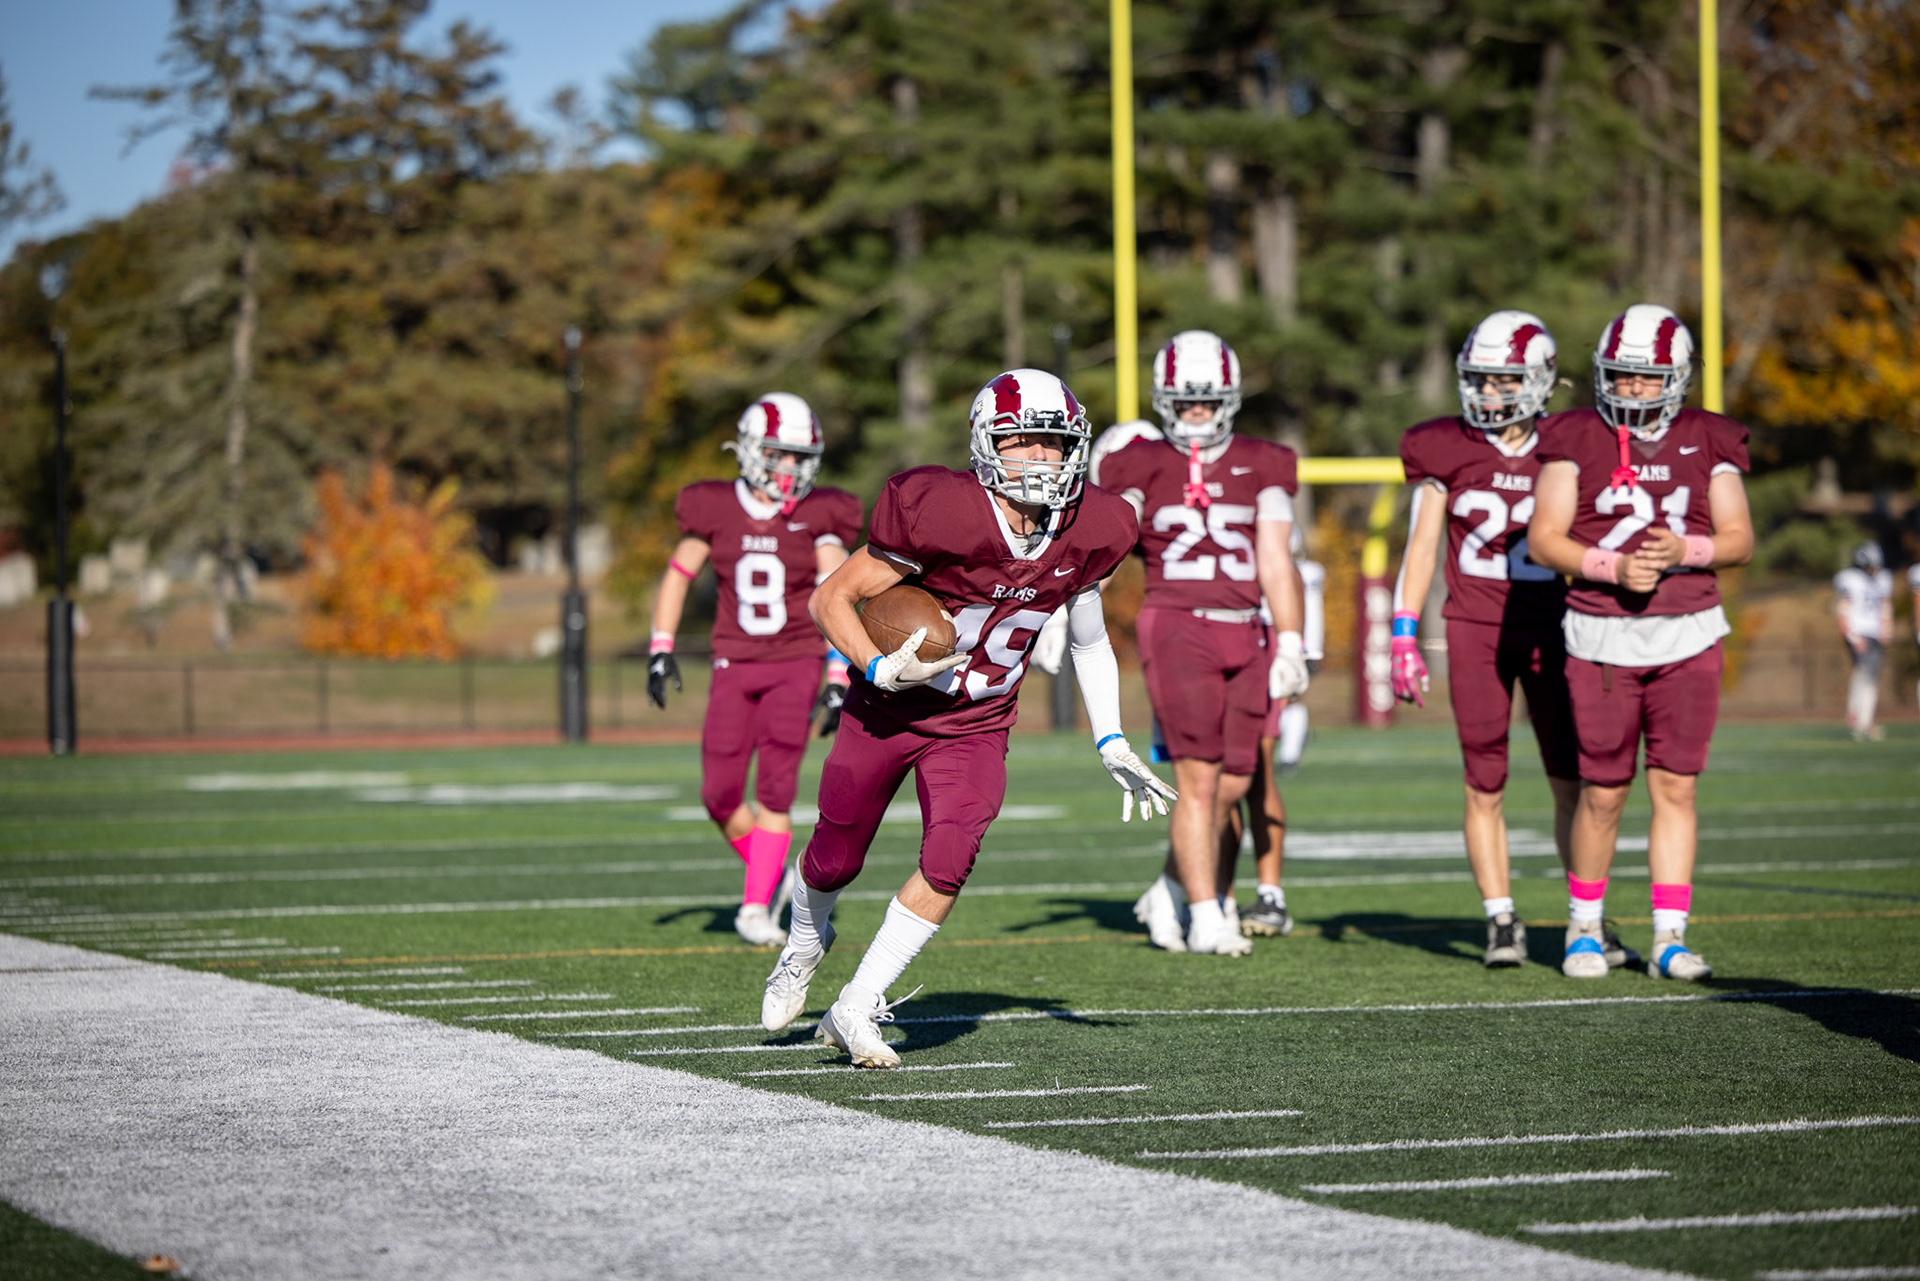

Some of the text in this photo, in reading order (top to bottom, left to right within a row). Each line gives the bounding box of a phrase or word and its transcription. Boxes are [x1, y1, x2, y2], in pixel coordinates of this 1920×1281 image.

[1491, 471, 1533, 492] RAMS
[1152, 502, 1257, 581] 25
[1594, 484, 1691, 574] 21
[735, 552, 788, 636] 8
[992, 584, 1038, 604] RAMS
